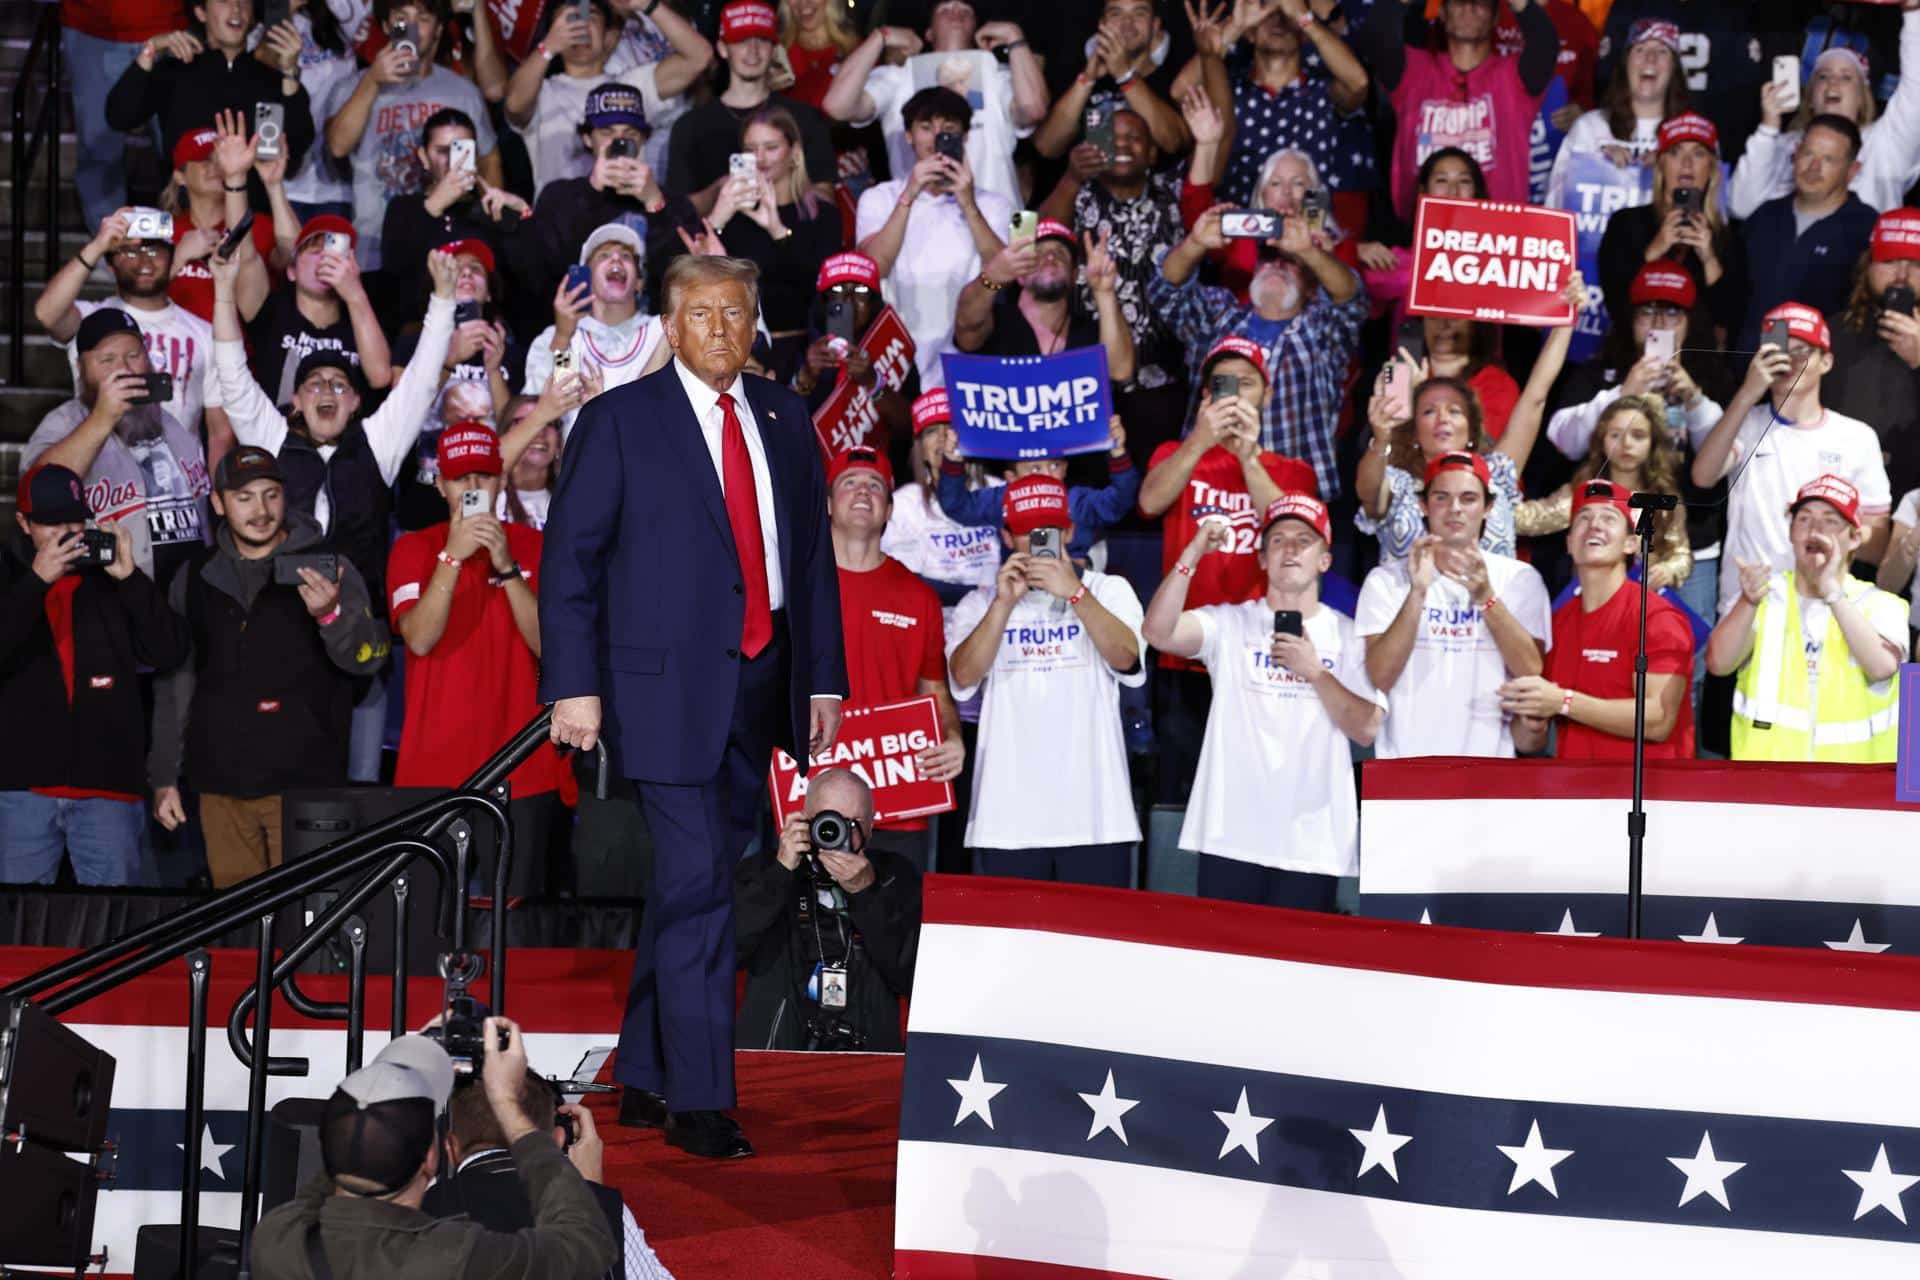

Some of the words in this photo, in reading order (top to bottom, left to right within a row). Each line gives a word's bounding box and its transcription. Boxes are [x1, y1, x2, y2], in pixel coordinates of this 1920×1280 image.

[376, 102, 443, 134] DETR
[1423, 101, 1487, 135] TRUMP
[1425, 228, 1517, 256] DREAM
[1522, 236, 1571, 265] BIG,
[1424, 252, 1560, 292] AGAIN!
[956, 377, 1099, 415] TRUMP
[961, 408, 1024, 432] WILL
[1028, 409, 1070, 432] FIX
[1075, 402, 1099, 423] IT
[1009, 487, 1031, 500] MAKE
[1032, 484, 1065, 497] AMERICA
[1015, 499, 1039, 512] GREAT
[1040, 498, 1063, 509] AGAIN
[930, 528, 994, 549] TRUMP
[949, 543, 993, 559] VANCE
[1005, 625, 1080, 645] TRUMP
[1431, 625, 1473, 637] VANCE
[1021, 645, 1064, 657] VANCE
